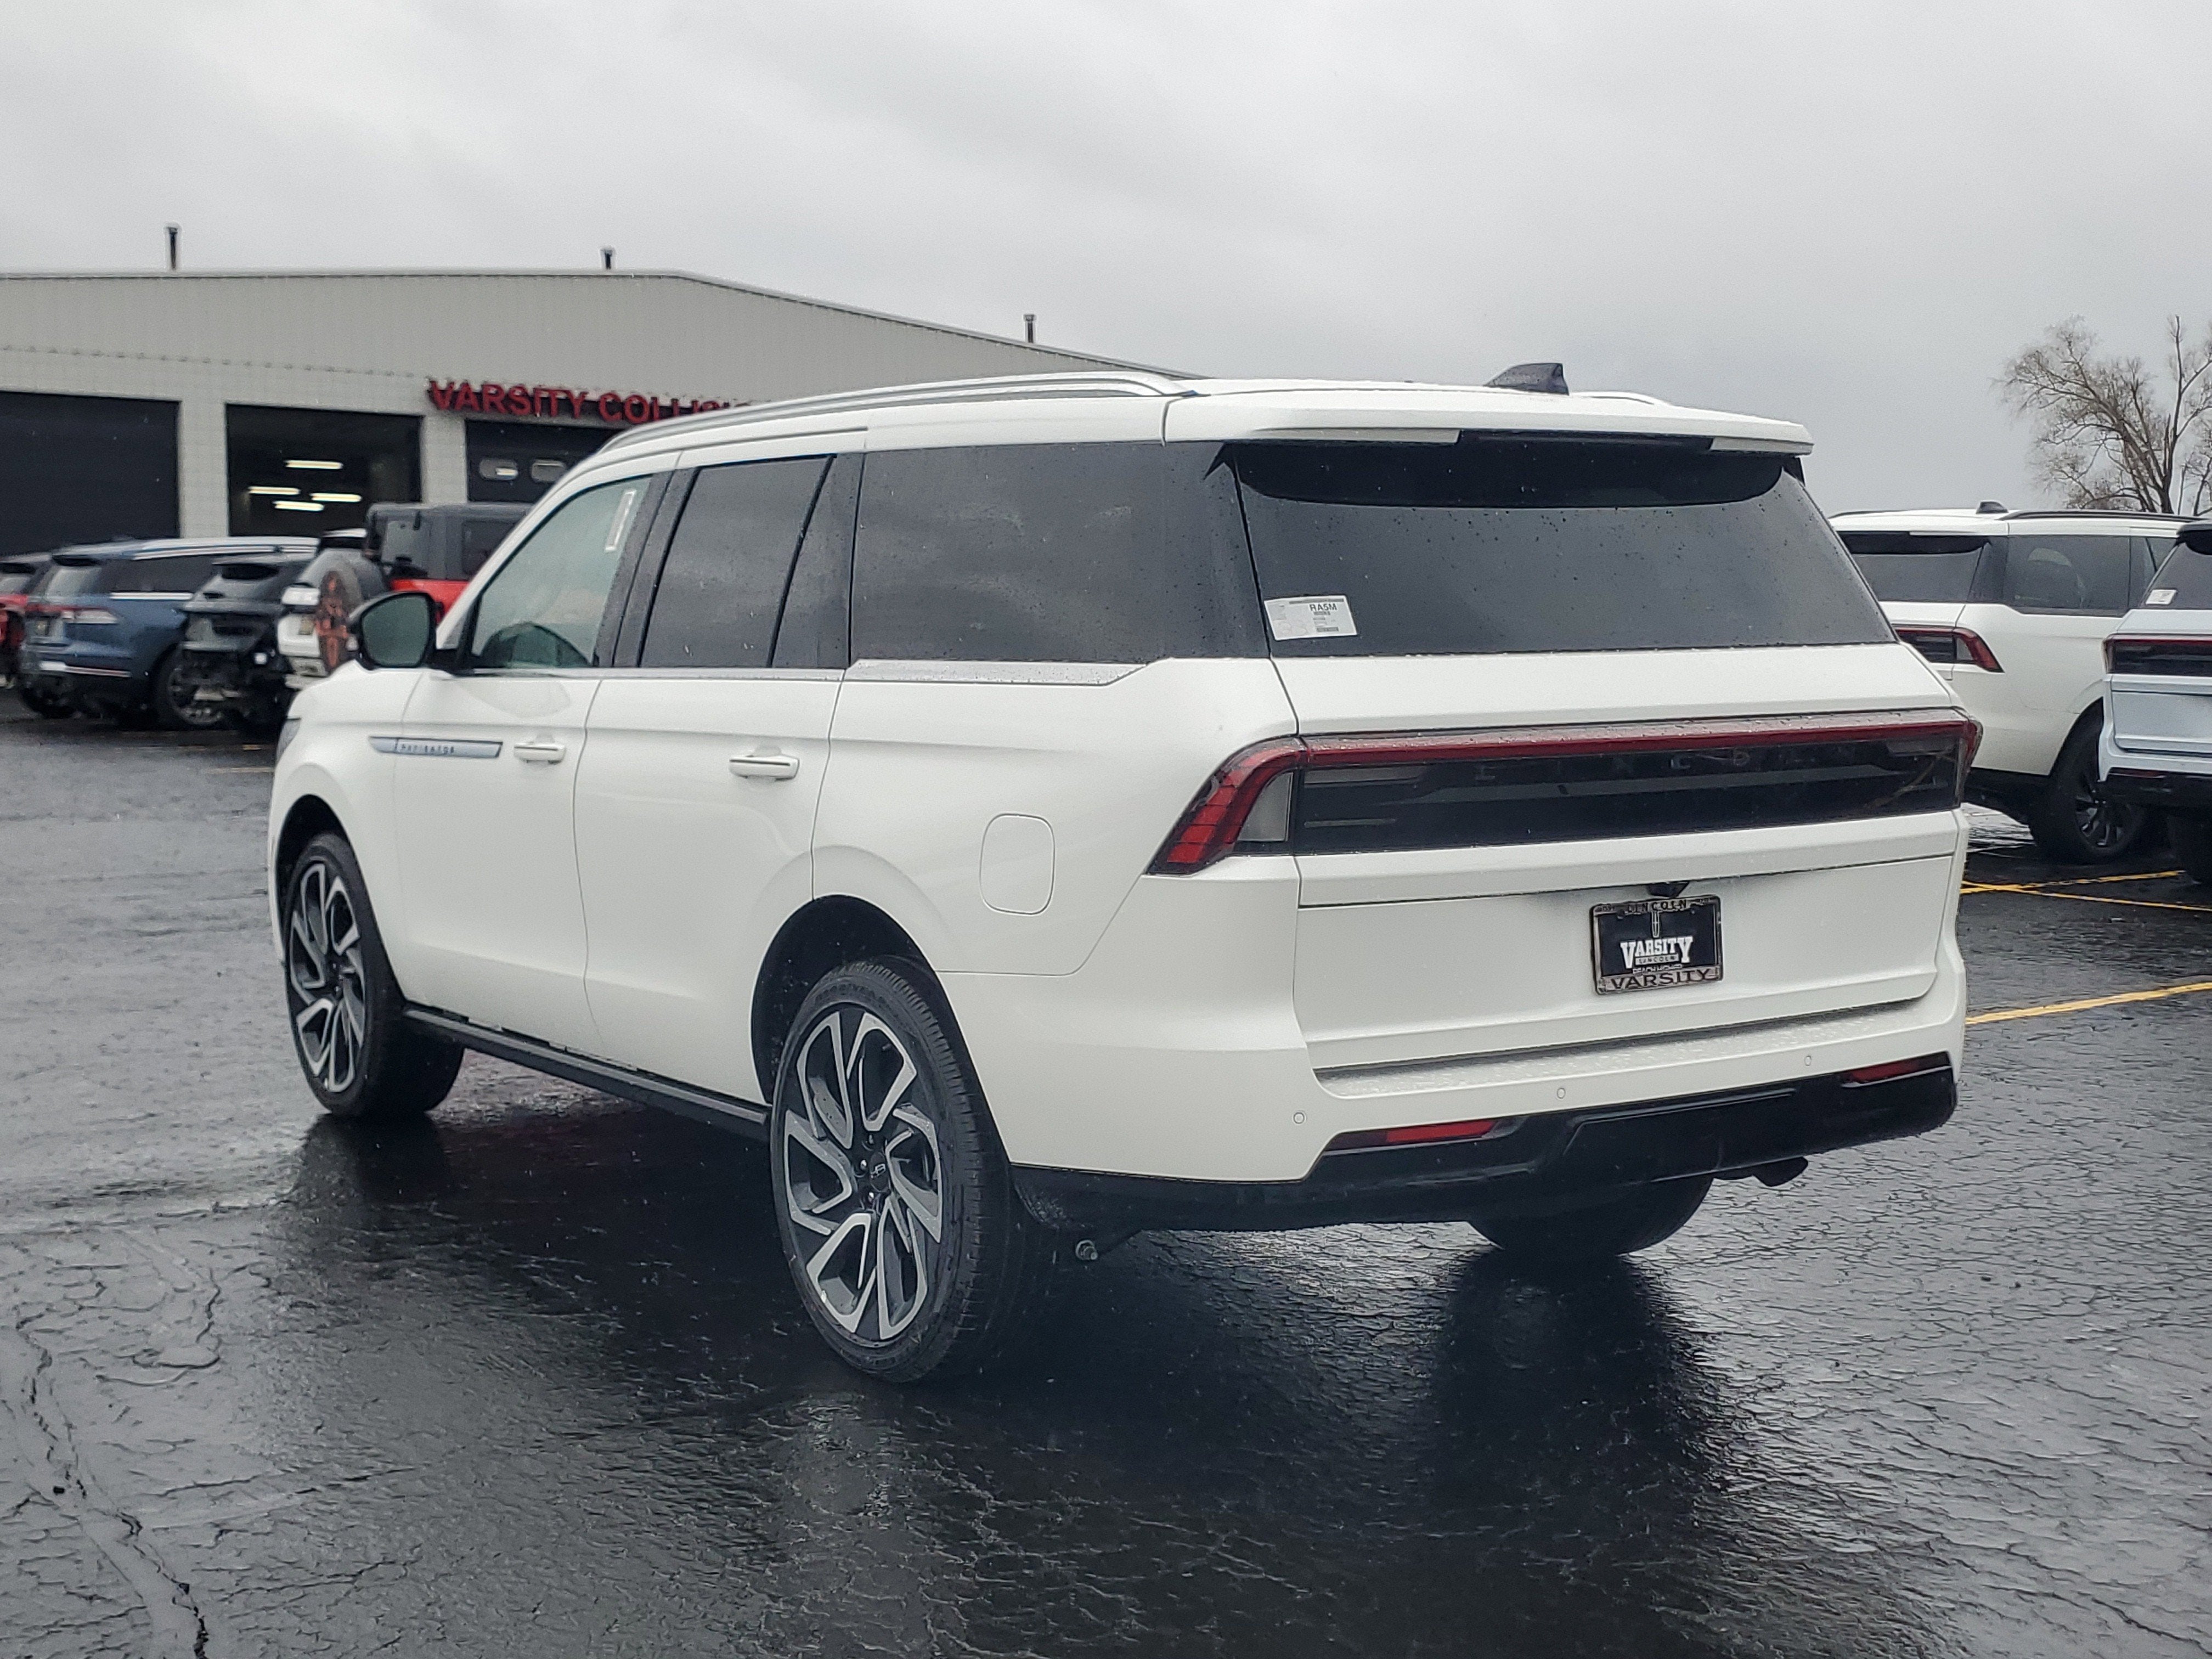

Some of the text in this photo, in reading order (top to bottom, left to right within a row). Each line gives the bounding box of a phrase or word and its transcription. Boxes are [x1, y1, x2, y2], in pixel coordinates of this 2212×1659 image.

[428, 380, 589, 419] VARSITY
[1620, 936, 1694, 969] VARSITY
[1611, 968, 1711, 989] VARSITY
